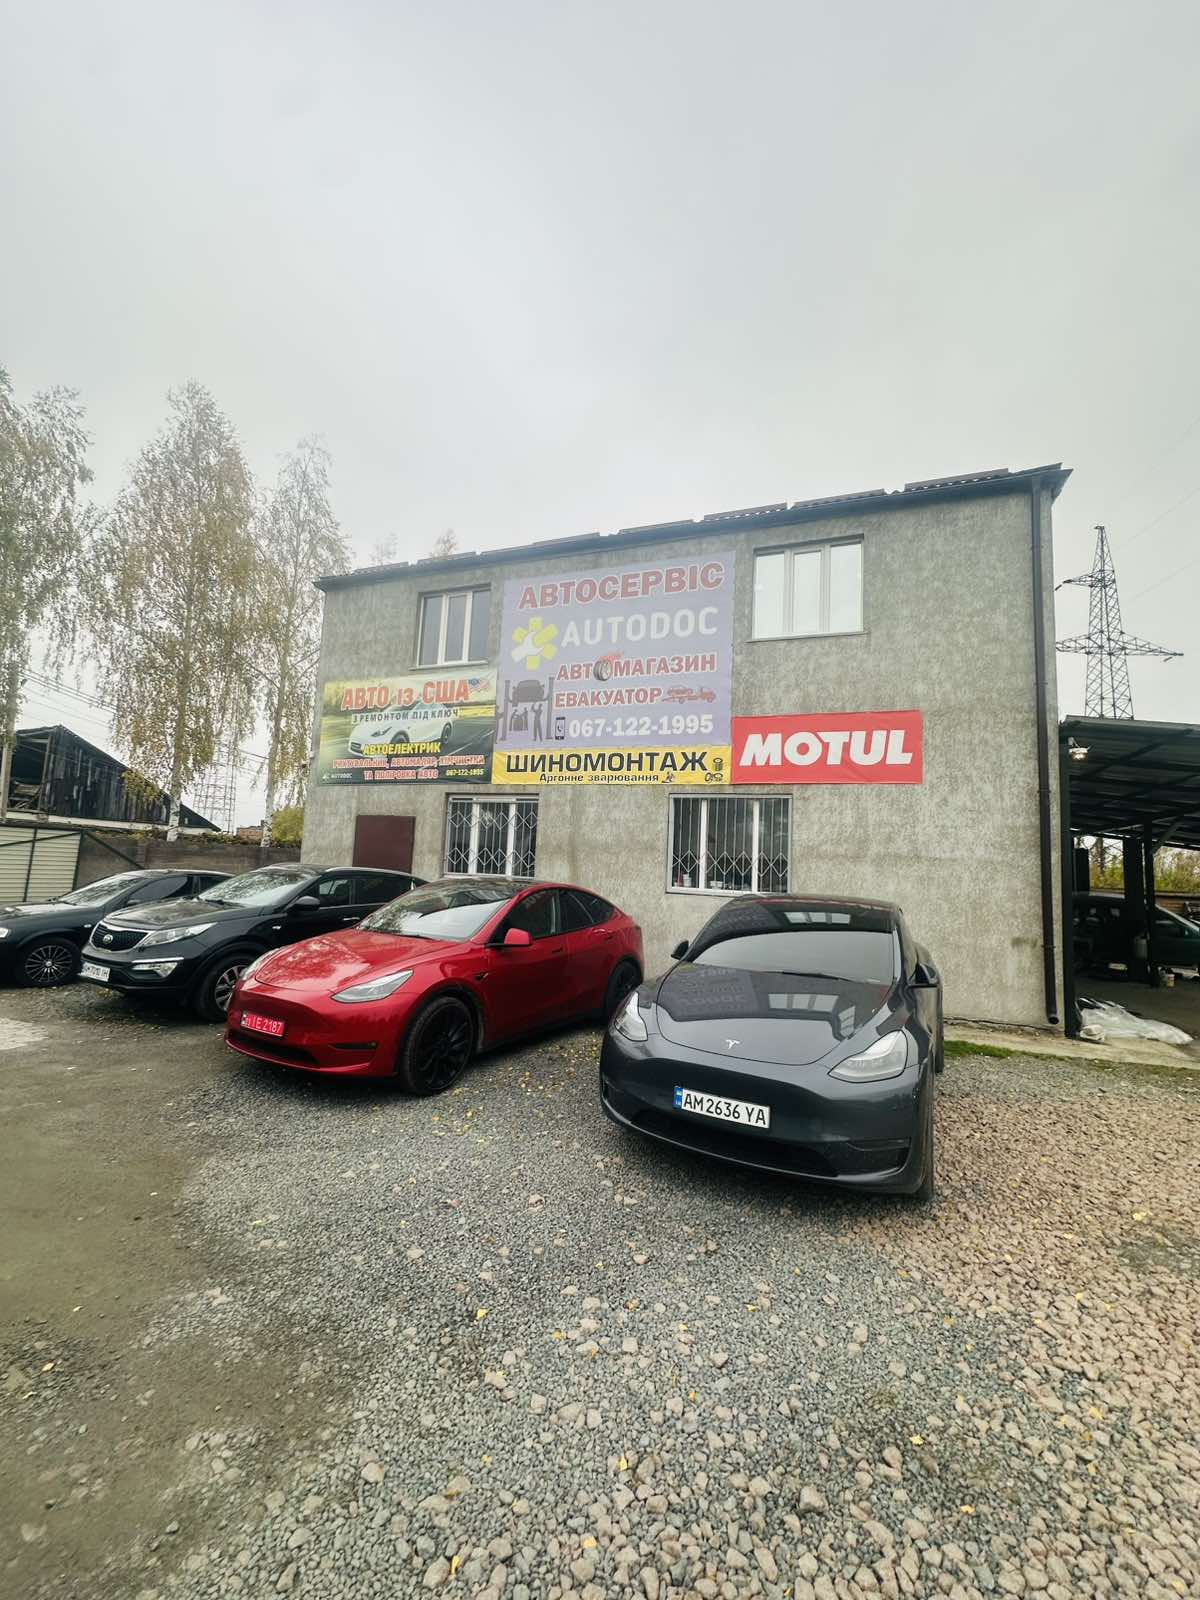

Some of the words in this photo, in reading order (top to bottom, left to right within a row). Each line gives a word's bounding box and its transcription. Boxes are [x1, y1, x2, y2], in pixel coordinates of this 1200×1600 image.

[519, 562, 724, 609] АВТОСЕРВІС
[560, 606, 719, 648] AUTODOC
[341, 687, 389, 711] АВТО
[396, 687, 414, 705] ІЗ
[422, 679, 470, 704] США
[554, 687, 662, 708] ЕВАКУАТОР
[359, 711, 409, 722] РЕМОНТОМ
[411, 710, 430, 720] ПІД
[431, 708, 459, 719] КЛЮЧ
[568, 713, 714, 738] 067-122-1995
[363, 742, 441, 755] АВТОЕЛЕКТРИК
[739, 729, 913, 766] MOTUL
[506, 751, 708, 773] ШИНОМОНТАЖ
[539, 773, 584, 783] Аргонне
[588, 773, 659, 784] зварювання
